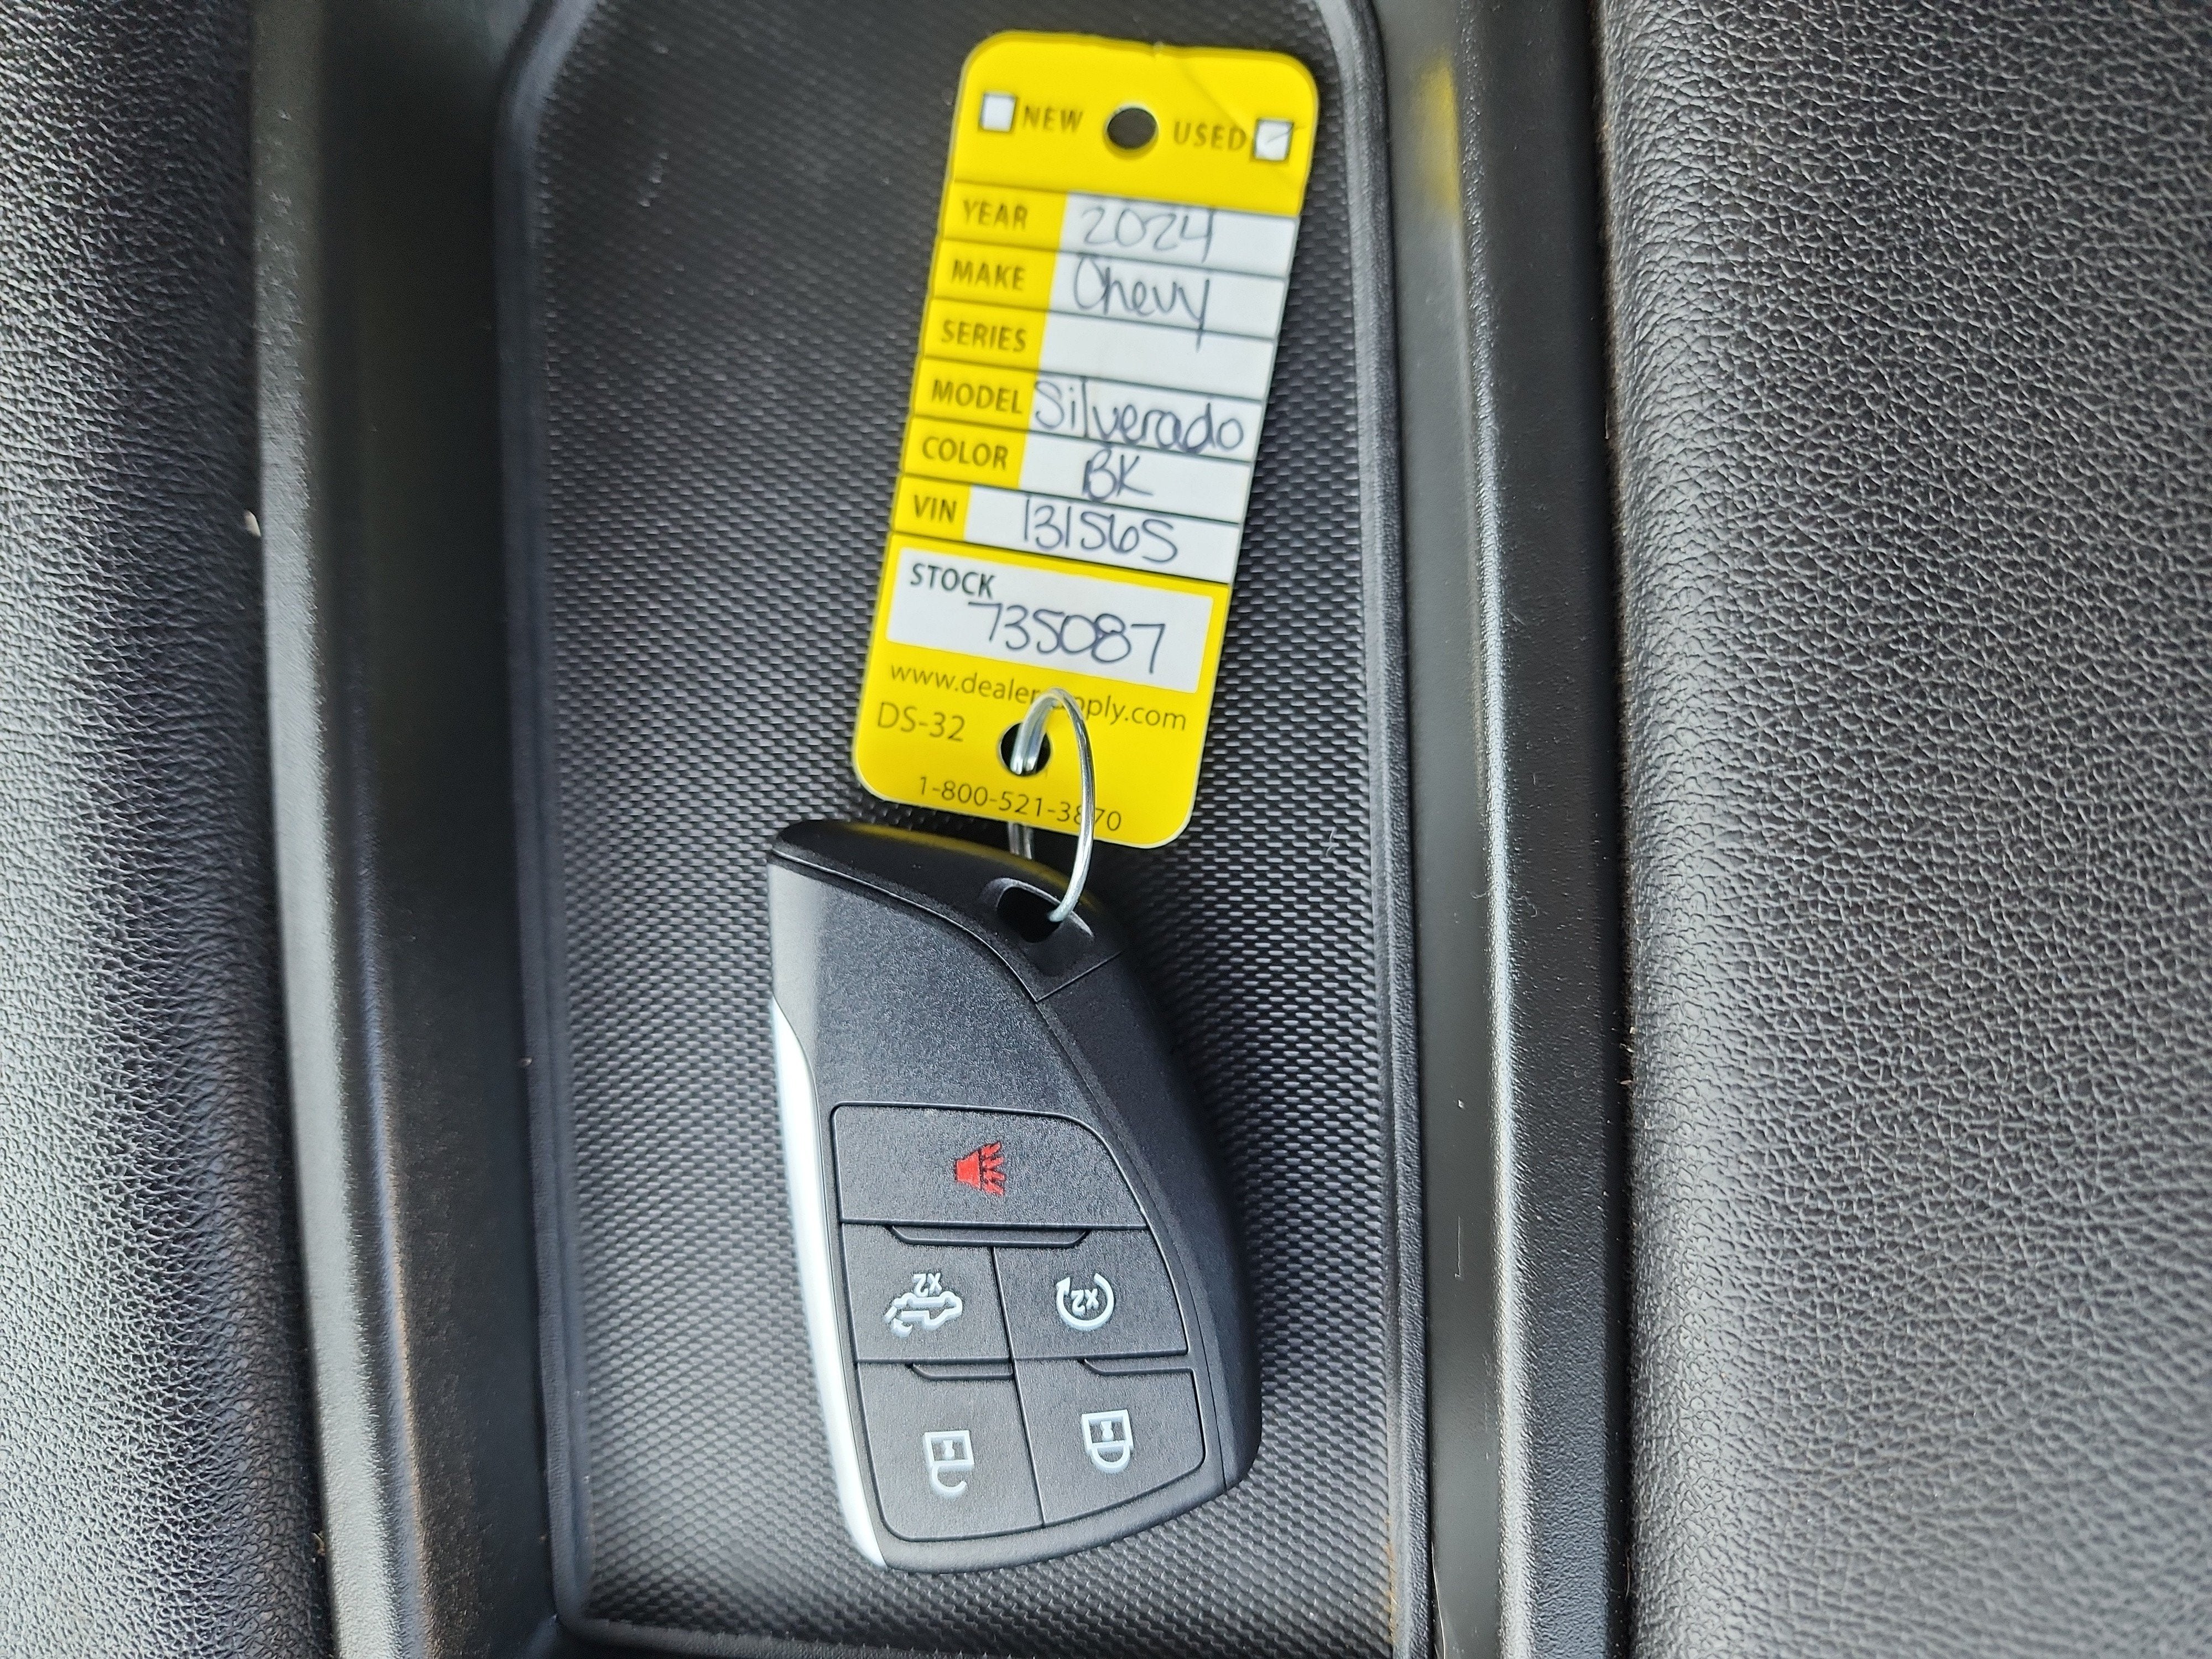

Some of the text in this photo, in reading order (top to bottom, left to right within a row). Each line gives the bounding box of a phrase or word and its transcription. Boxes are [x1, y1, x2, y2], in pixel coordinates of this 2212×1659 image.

[1022, 105, 1084, 134] NEW
[1173, 121, 1246, 152] USED
[963, 200, 1028, 230] YEAR
[1082, 205, 1215, 263] 2024
[951, 259, 1025, 291] MAKE
[941, 319, 1026, 353] SERIES
[931, 379, 1022, 415] MODEL
[1033, 375, 1244, 454] Silverado
[922, 436, 1009, 469] COLOR
[913, 495, 958, 523] VIN
[910, 563, 997, 599] STOCK
[968, 601, 1166, 674] 735087
[877, 701, 964, 742] DS-32
